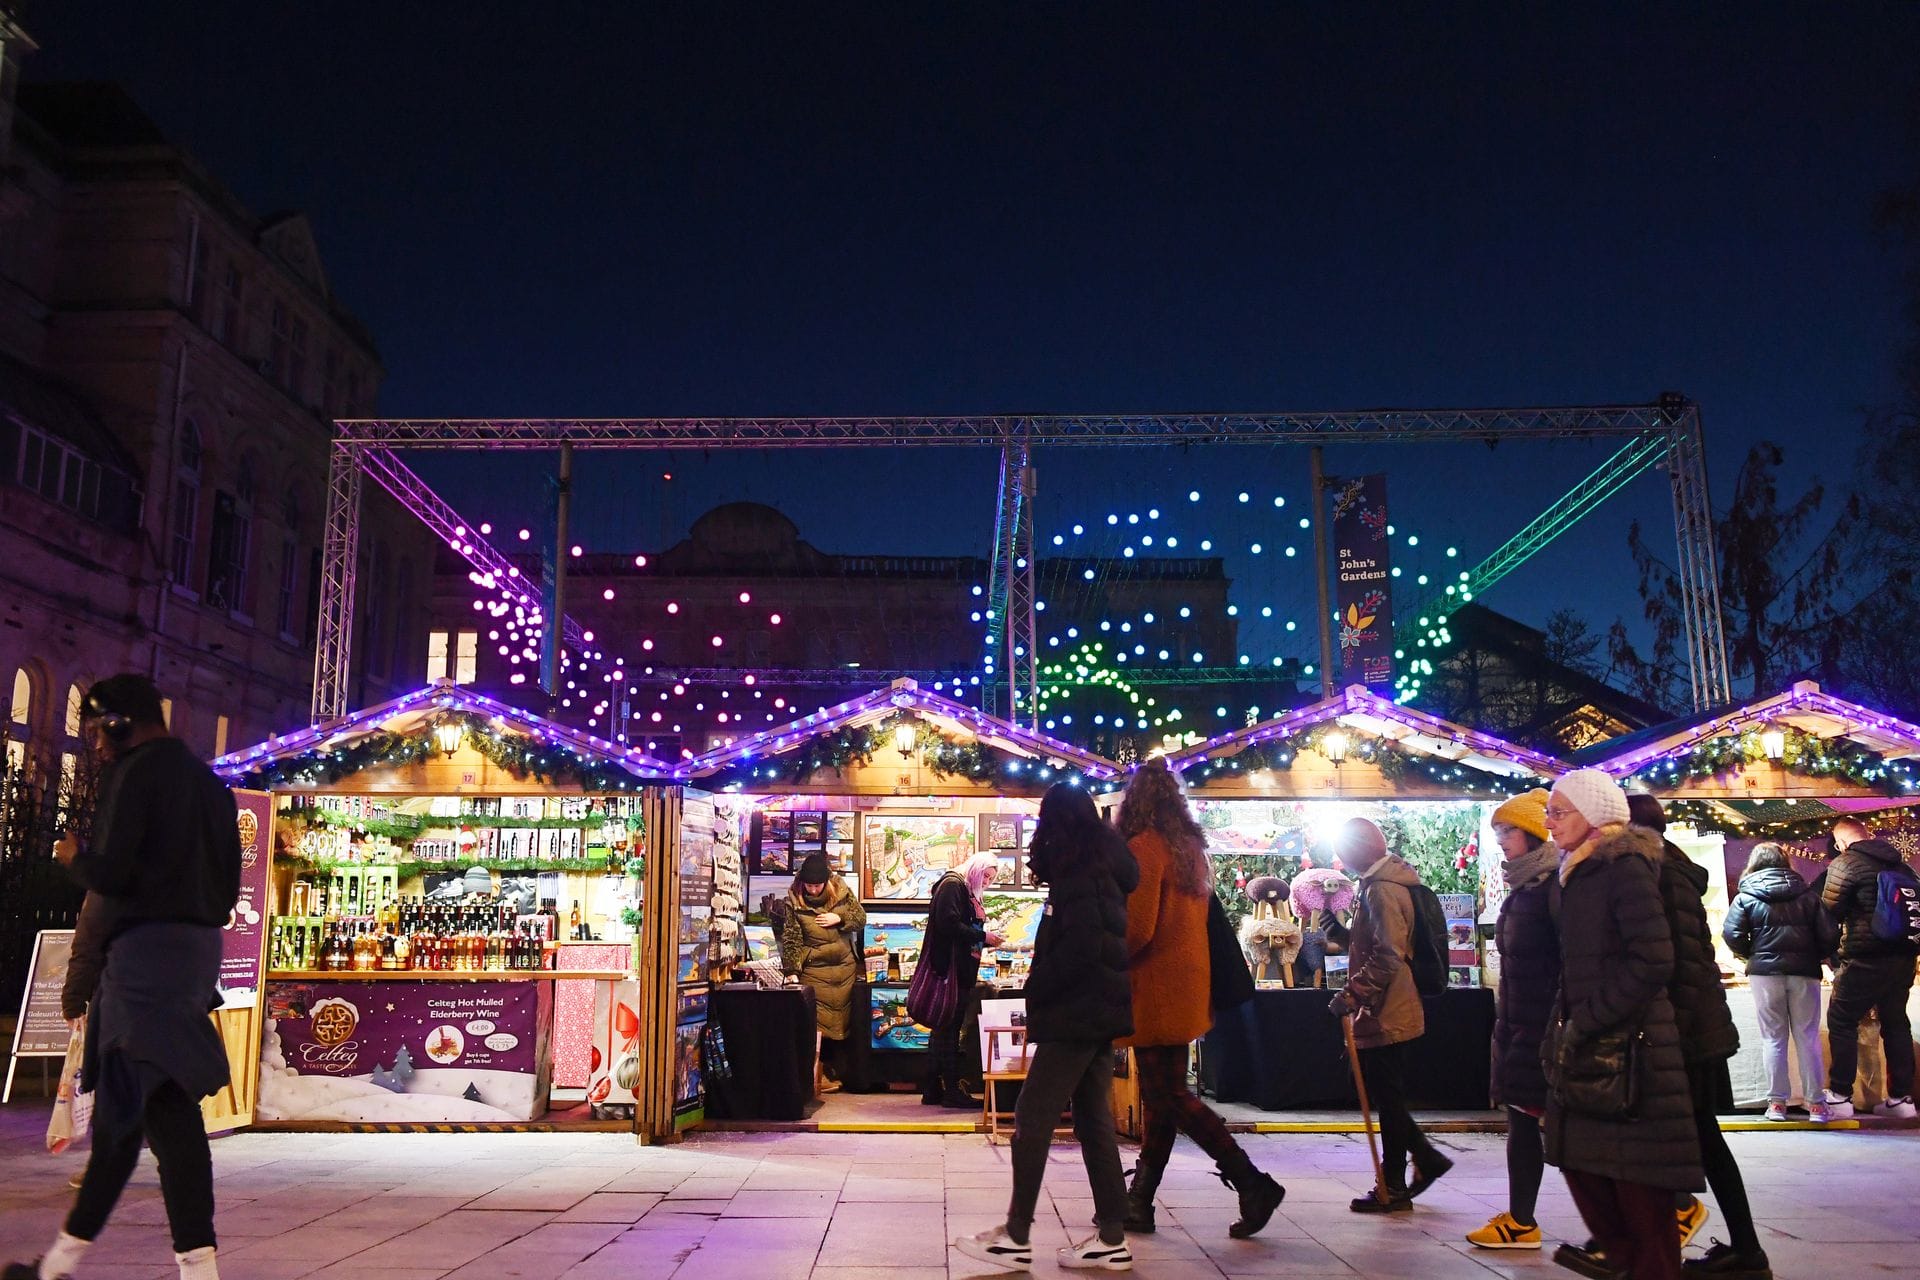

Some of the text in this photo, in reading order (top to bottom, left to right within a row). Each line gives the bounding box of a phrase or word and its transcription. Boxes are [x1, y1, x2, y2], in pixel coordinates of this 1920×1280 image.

[1340, 549, 1351, 558] St
[1340, 559, 1376, 570] John's
[1341, 571, 1386, 581] Gardens
[464, 775, 473, 783] 17
[900, 777, 909, 785] 16
[1747, 779, 1756, 787] 14
[1900, 887, 1920, 944] DKNY
[427, 998, 504, 1008] Celteg Hot Mulled
[430, 1009, 500, 1020] Elderberry Wine
[299, 1040, 359, 1073] Celteg
